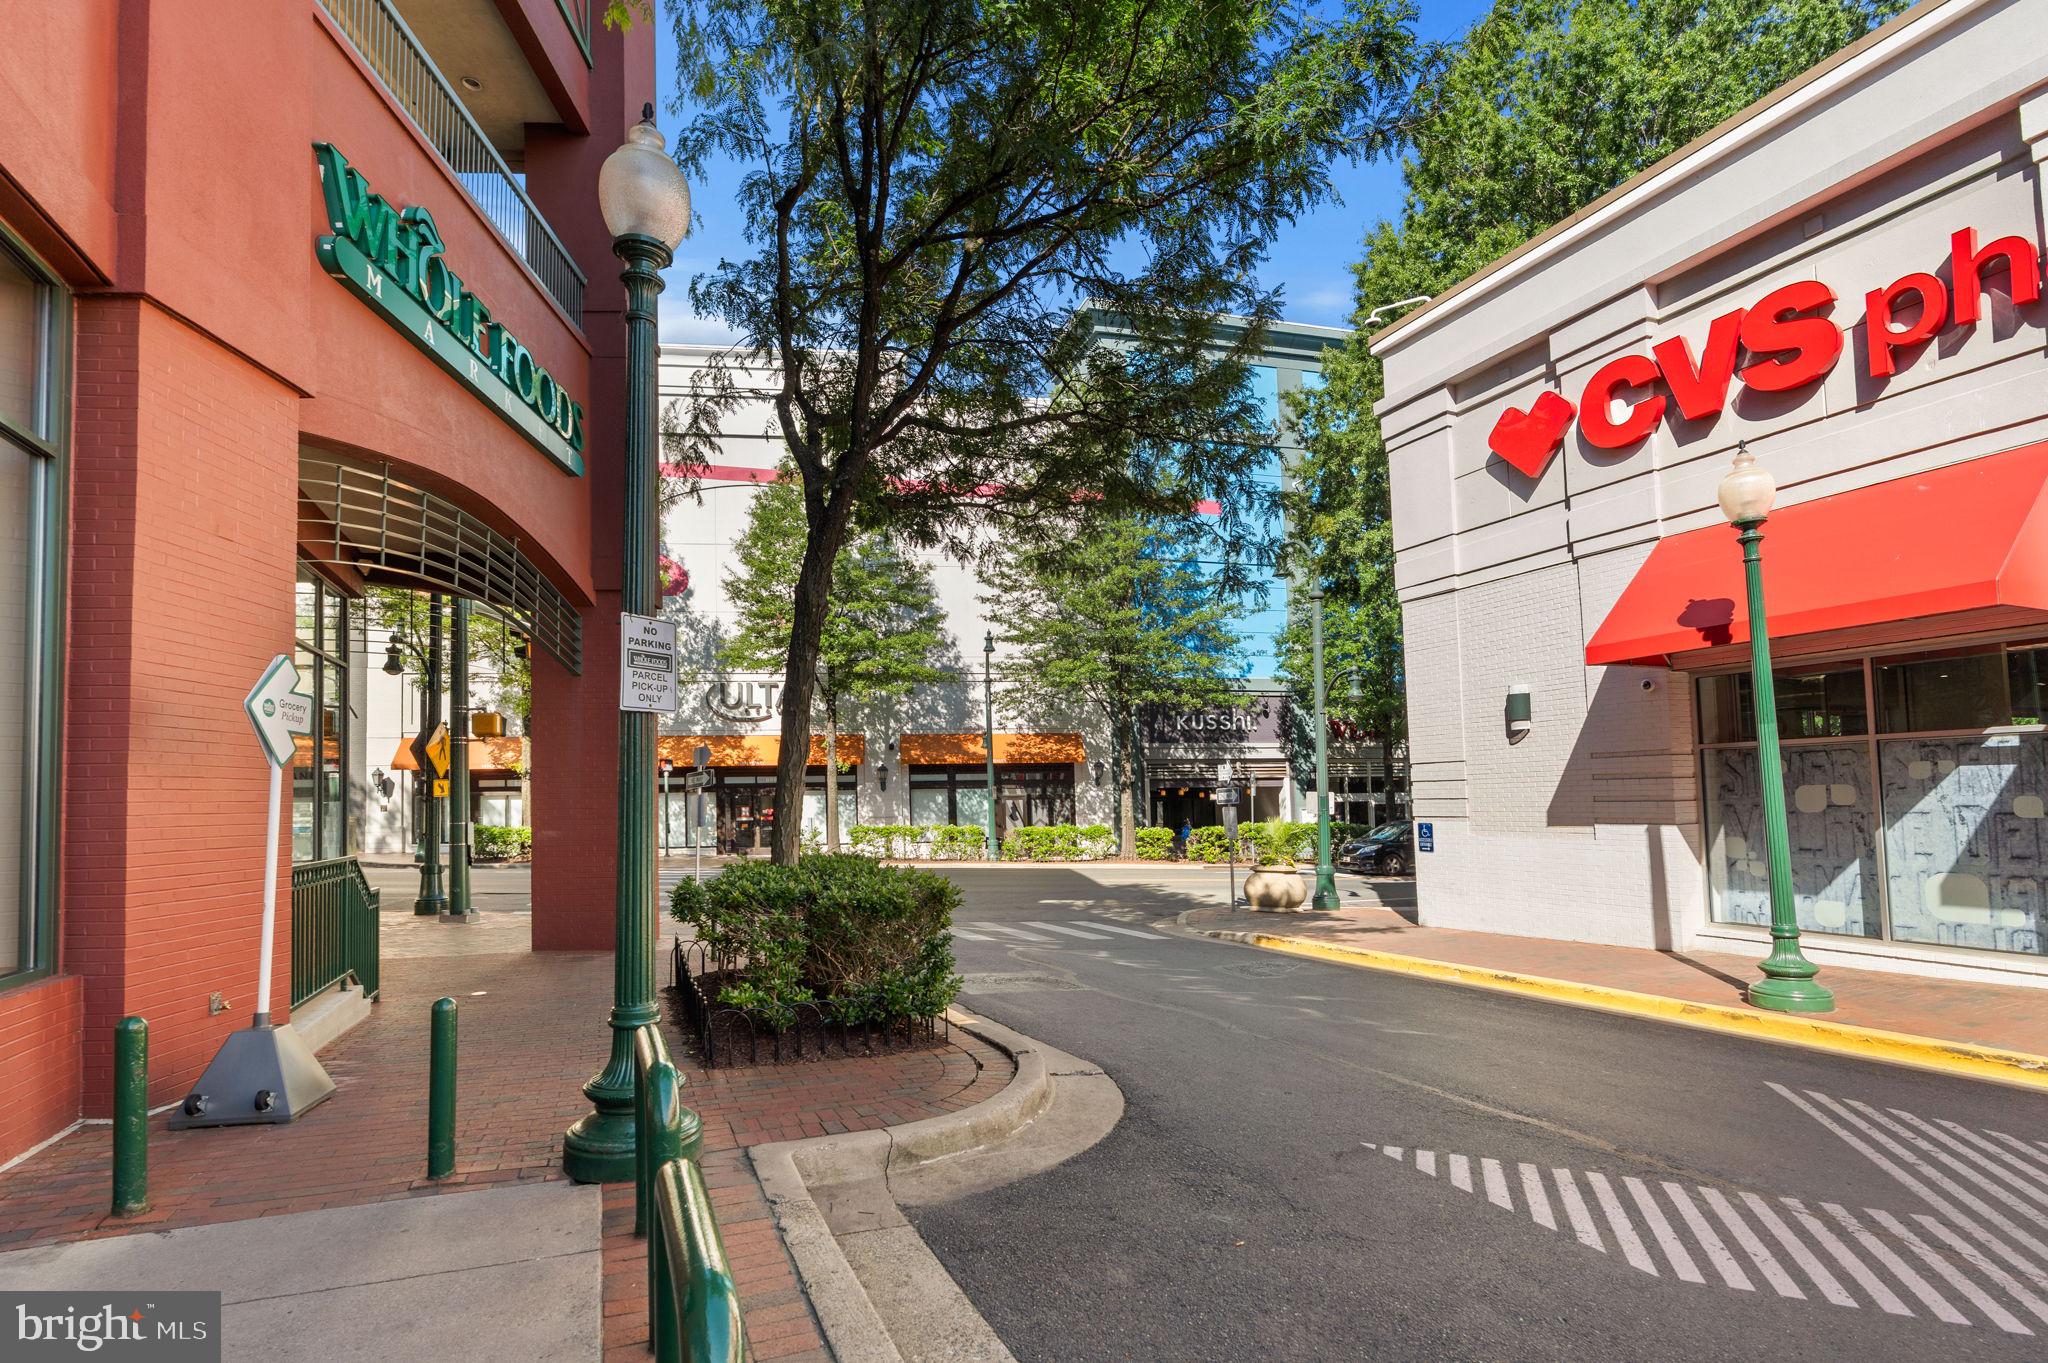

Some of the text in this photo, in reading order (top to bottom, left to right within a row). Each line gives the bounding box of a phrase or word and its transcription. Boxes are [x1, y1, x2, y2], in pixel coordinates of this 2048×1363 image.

[311, 142, 585, 452] WHOLE FOODS
[1578, 227, 2048, 449] CVS ph
[366, 264, 573, 466] MARKET
[643, 626, 658, 636] NO
[628, 636, 672, 651] PARKING
[632, 670, 668, 683] PARCEL
[631, 681, 668, 693] PICK-UP
[638, 693, 662, 703] ONLY
[279, 698, 307, 714] Grocery
[282, 711, 304, 726] Pickup
